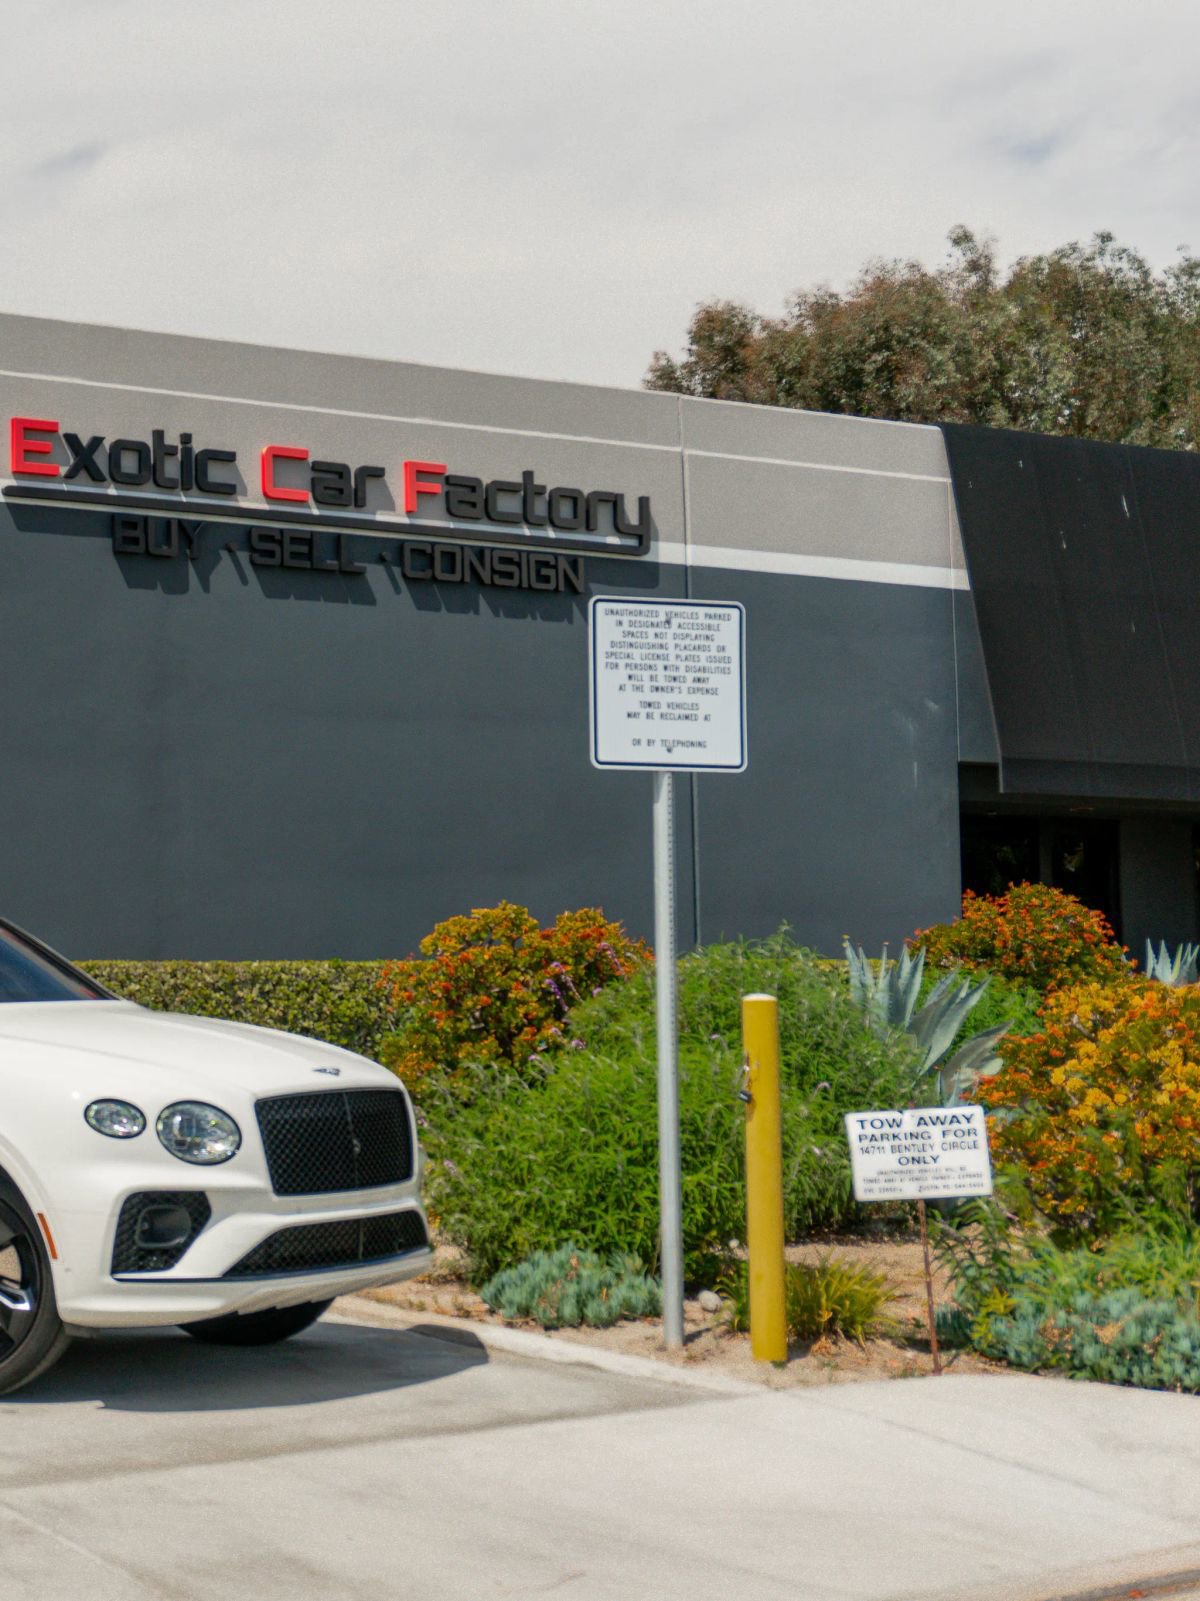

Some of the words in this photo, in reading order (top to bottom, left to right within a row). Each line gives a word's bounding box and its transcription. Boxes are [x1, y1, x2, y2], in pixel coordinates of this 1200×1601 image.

[10, 417, 236, 495] Exotic
[261, 445, 385, 507] Car
[404, 460, 650, 556] Factory
[112, 513, 206, 560] BUY
[249, 527, 366, 574] SELL
[403, 541, 585, 592] CONSIGN
[605, 609, 659, 617] UNAUTHORIZED
[705, 613, 732, 621] PARKED
[616, 619, 623, 627] IN
[629, 620, 672, 629] DESIGNATED
[678, 623, 720, 631] ACCESSIBLE
[673, 633, 714, 641] DISPLAYING
[610, 641, 669, 650] DISTINGUISHING
[675, 644, 711, 652] PLACARDS
[605, 652, 634, 660] SPECIAL
[640, 653, 670, 661] LICENSE
[706, 656, 732, 664] ISSUED
[605, 662, 618, 670] FOR
[625, 663, 658, 671] PERSONS
[685, 665, 731, 674] DISABILITIES
[628, 674, 643, 682] WILL
[664, 675, 687, 683] TOWED
[632, 685, 644, 693] THE
[650, 686, 682, 694] OWNER'S
[687, 687, 719, 695] EXPENSE
[640, 701, 661, 709] TOWED
[667, 702, 699, 710] VEHICLES
[660, 713, 699, 721] RECLAIMED
[632, 738, 641, 746] OR
[660, 739, 707, 748] TELEPHONING
[856, 1118, 902, 1130] TOW
[916, 1114, 974, 1127] AWAY
[858, 1131, 931, 1143] PARKING
[942, 1128, 978, 1138] FOR
[860, 1146, 885, 1155] 14711
[891, 1143, 935, 1154] BENTLEY
[941, 1140, 979, 1151] CIRCLE
[898, 1155, 940, 1166] ONLY
